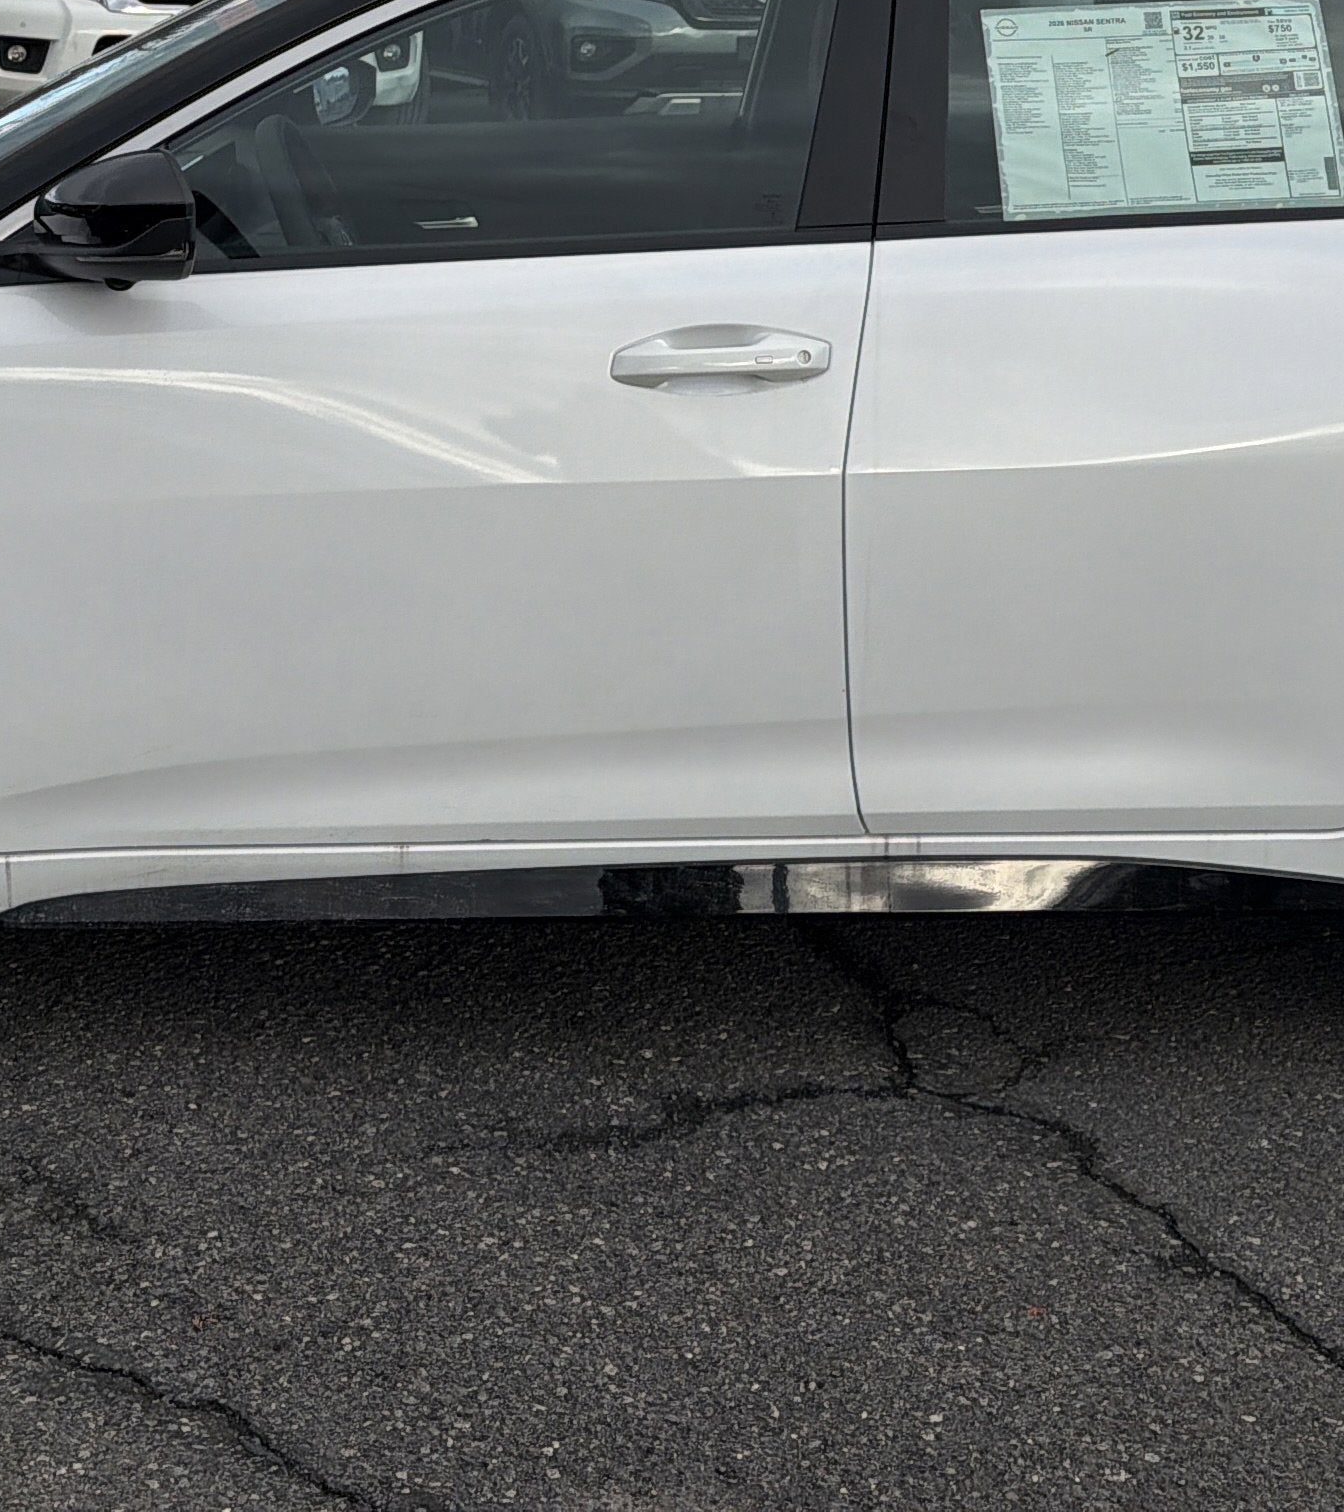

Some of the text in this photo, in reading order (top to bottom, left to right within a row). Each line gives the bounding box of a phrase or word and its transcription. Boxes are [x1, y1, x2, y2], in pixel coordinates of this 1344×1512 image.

[1096, 17, 1126, 25] SENTRA
[1183, 25, 1205, 41] 32
[1268, 24, 1293, 33] $750
[1181, 61, 1215, 72] $1,550
